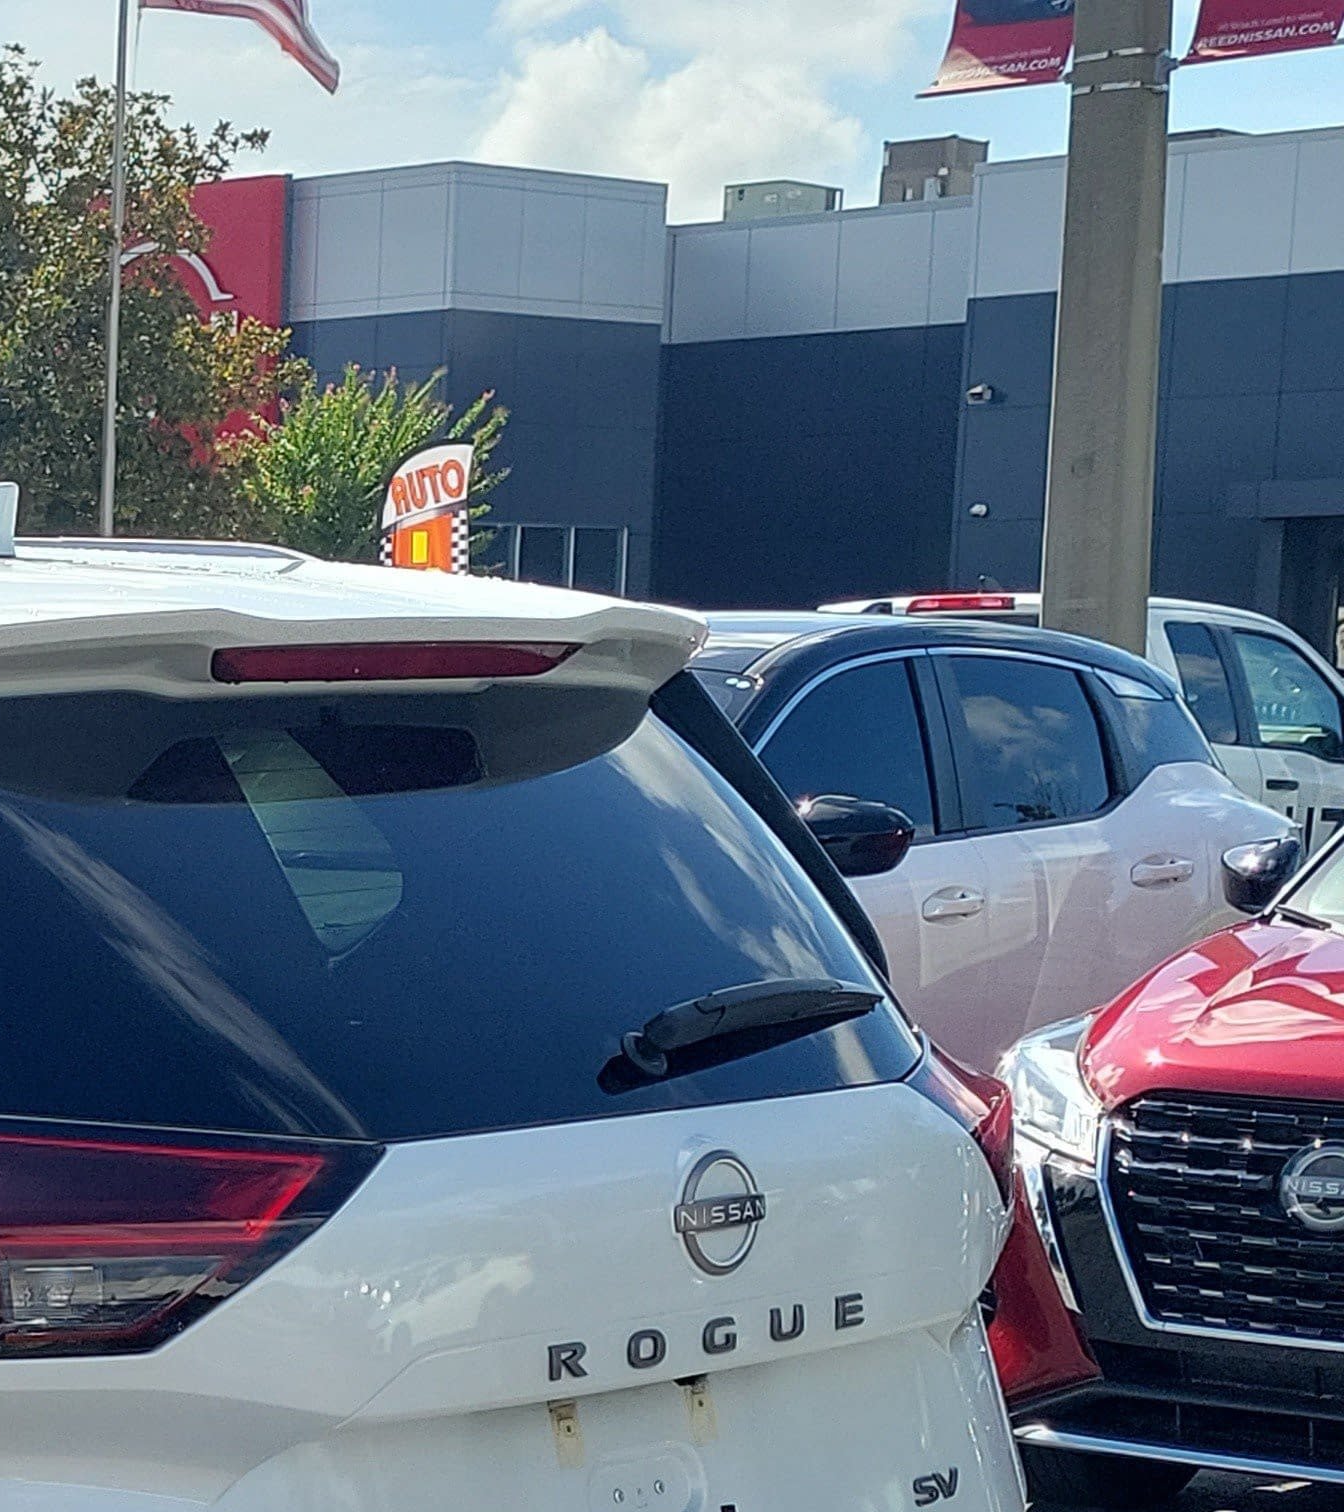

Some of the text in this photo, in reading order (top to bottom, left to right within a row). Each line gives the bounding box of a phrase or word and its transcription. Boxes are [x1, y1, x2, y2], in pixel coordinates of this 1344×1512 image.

[391, 458, 465, 516] AUTO
[680, 1199, 765, 1228] NISSAN
[547, 1292, 866, 1382] ROGUE
[912, 1466, 958, 1508] SV
